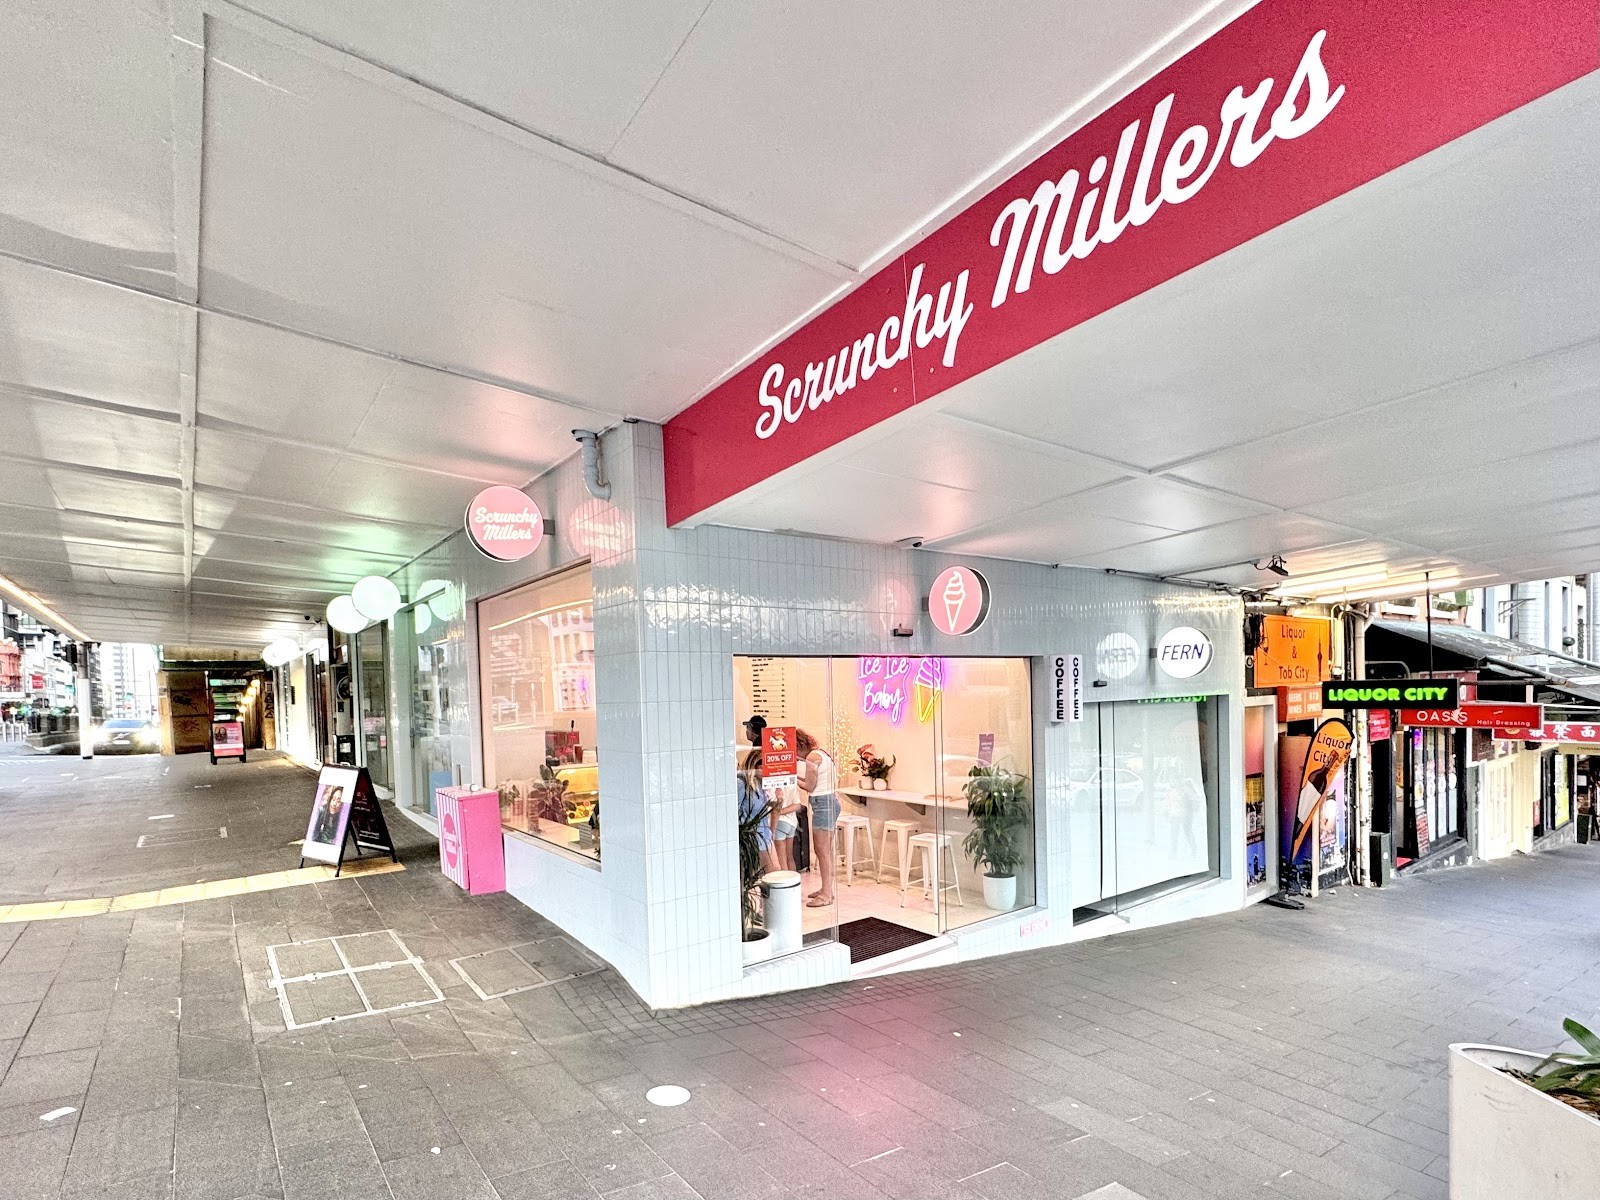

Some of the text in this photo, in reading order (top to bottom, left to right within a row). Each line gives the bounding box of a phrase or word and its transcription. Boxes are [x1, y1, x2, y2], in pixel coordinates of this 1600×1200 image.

[754, 28, 1346, 440] Scrunchy Millers
[474, 506, 538, 528] Scrunchy
[482, 523, 532, 540] Millers
[1281, 624, 1306, 642] Liquor
[1161, 643, 1204, 661] FERN
[1291, 645, 1297, 659] &
[858, 656, 909, 680] Ice Ice
[1278, 665, 1310, 682] Tob City
[1055, 657, 1065, 720] COFFEE
[1072, 657, 1080, 720] COFFEE
[1328, 688, 1400, 702] LIQUOR
[1404, 687, 1448, 701] CITY
[863, 681, 905, 723] Baby
[1495, 718, 1531, 728] Dressing
[1316, 732, 1352, 750] Liquor
[1313, 750, 1334, 767] City
